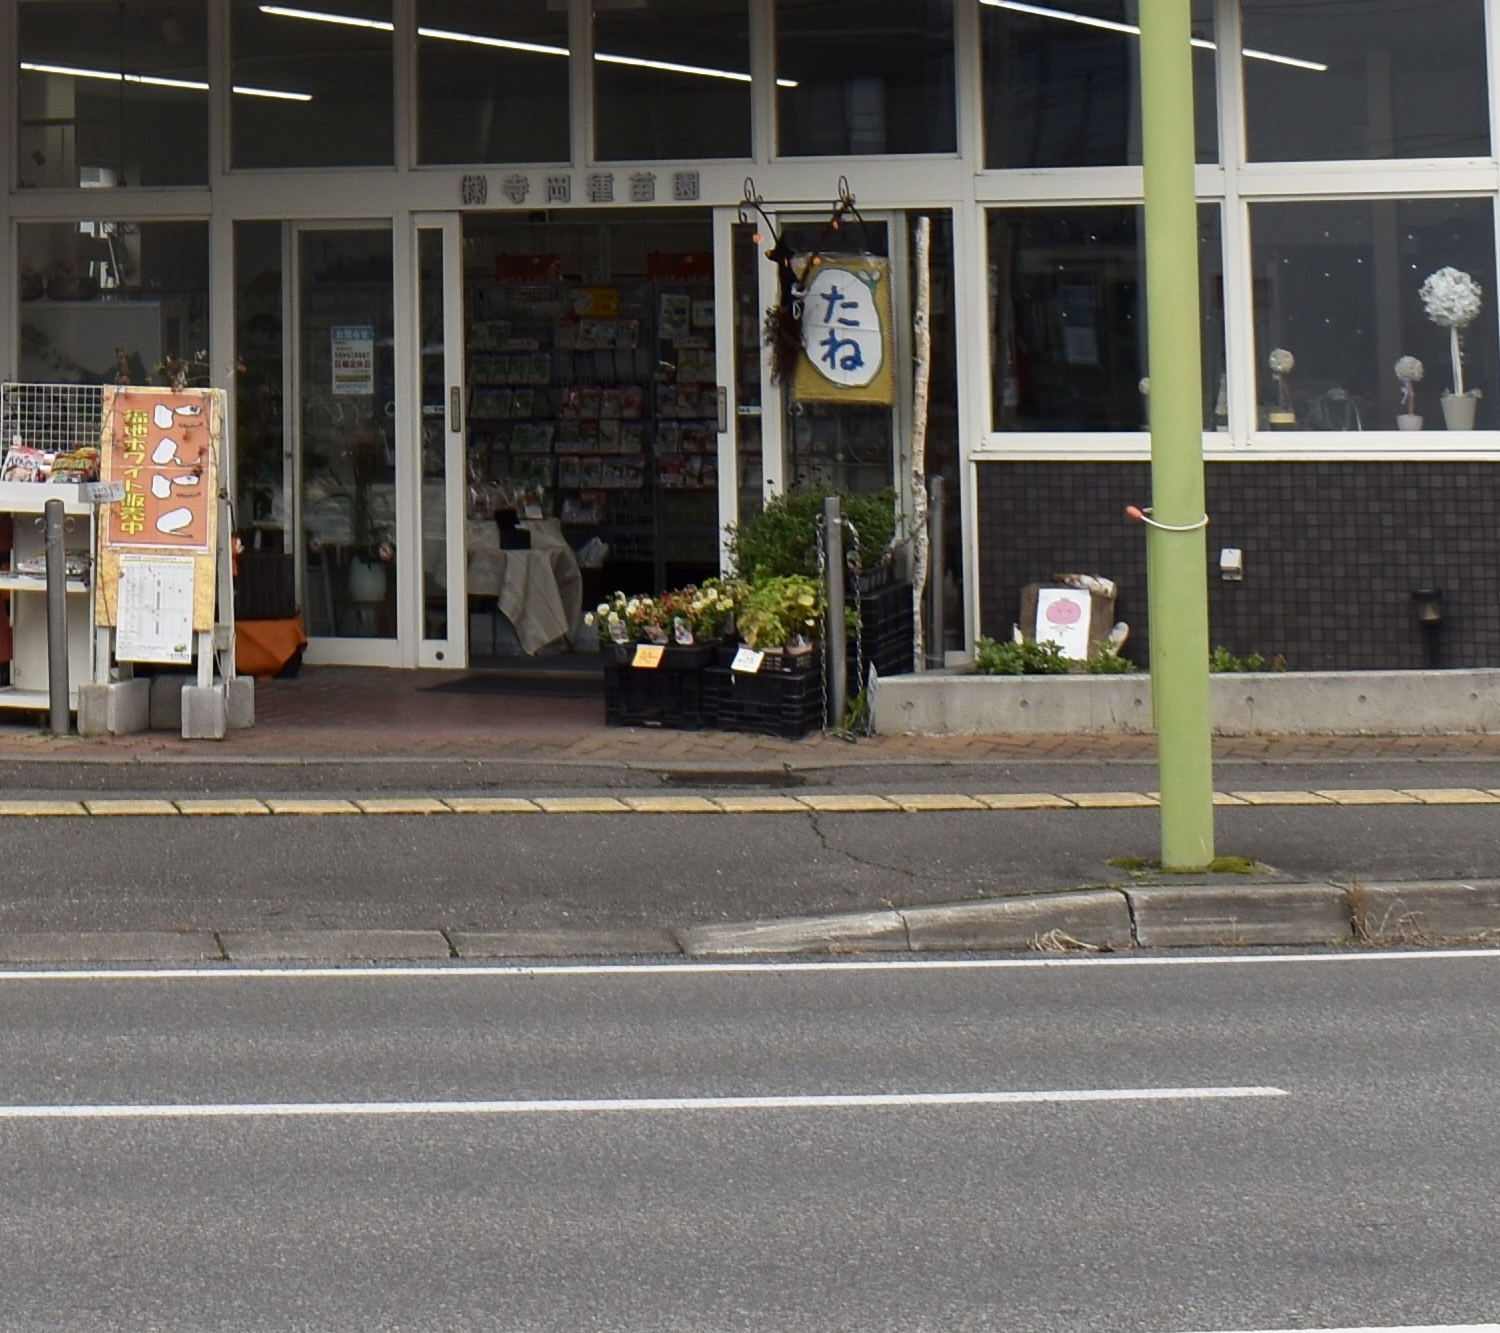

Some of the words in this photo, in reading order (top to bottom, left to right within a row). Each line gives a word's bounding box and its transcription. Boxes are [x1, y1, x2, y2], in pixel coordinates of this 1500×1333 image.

[820, 285, 864, 371] たね
[120, 410, 149, 536] 福地ホワイト販売中
